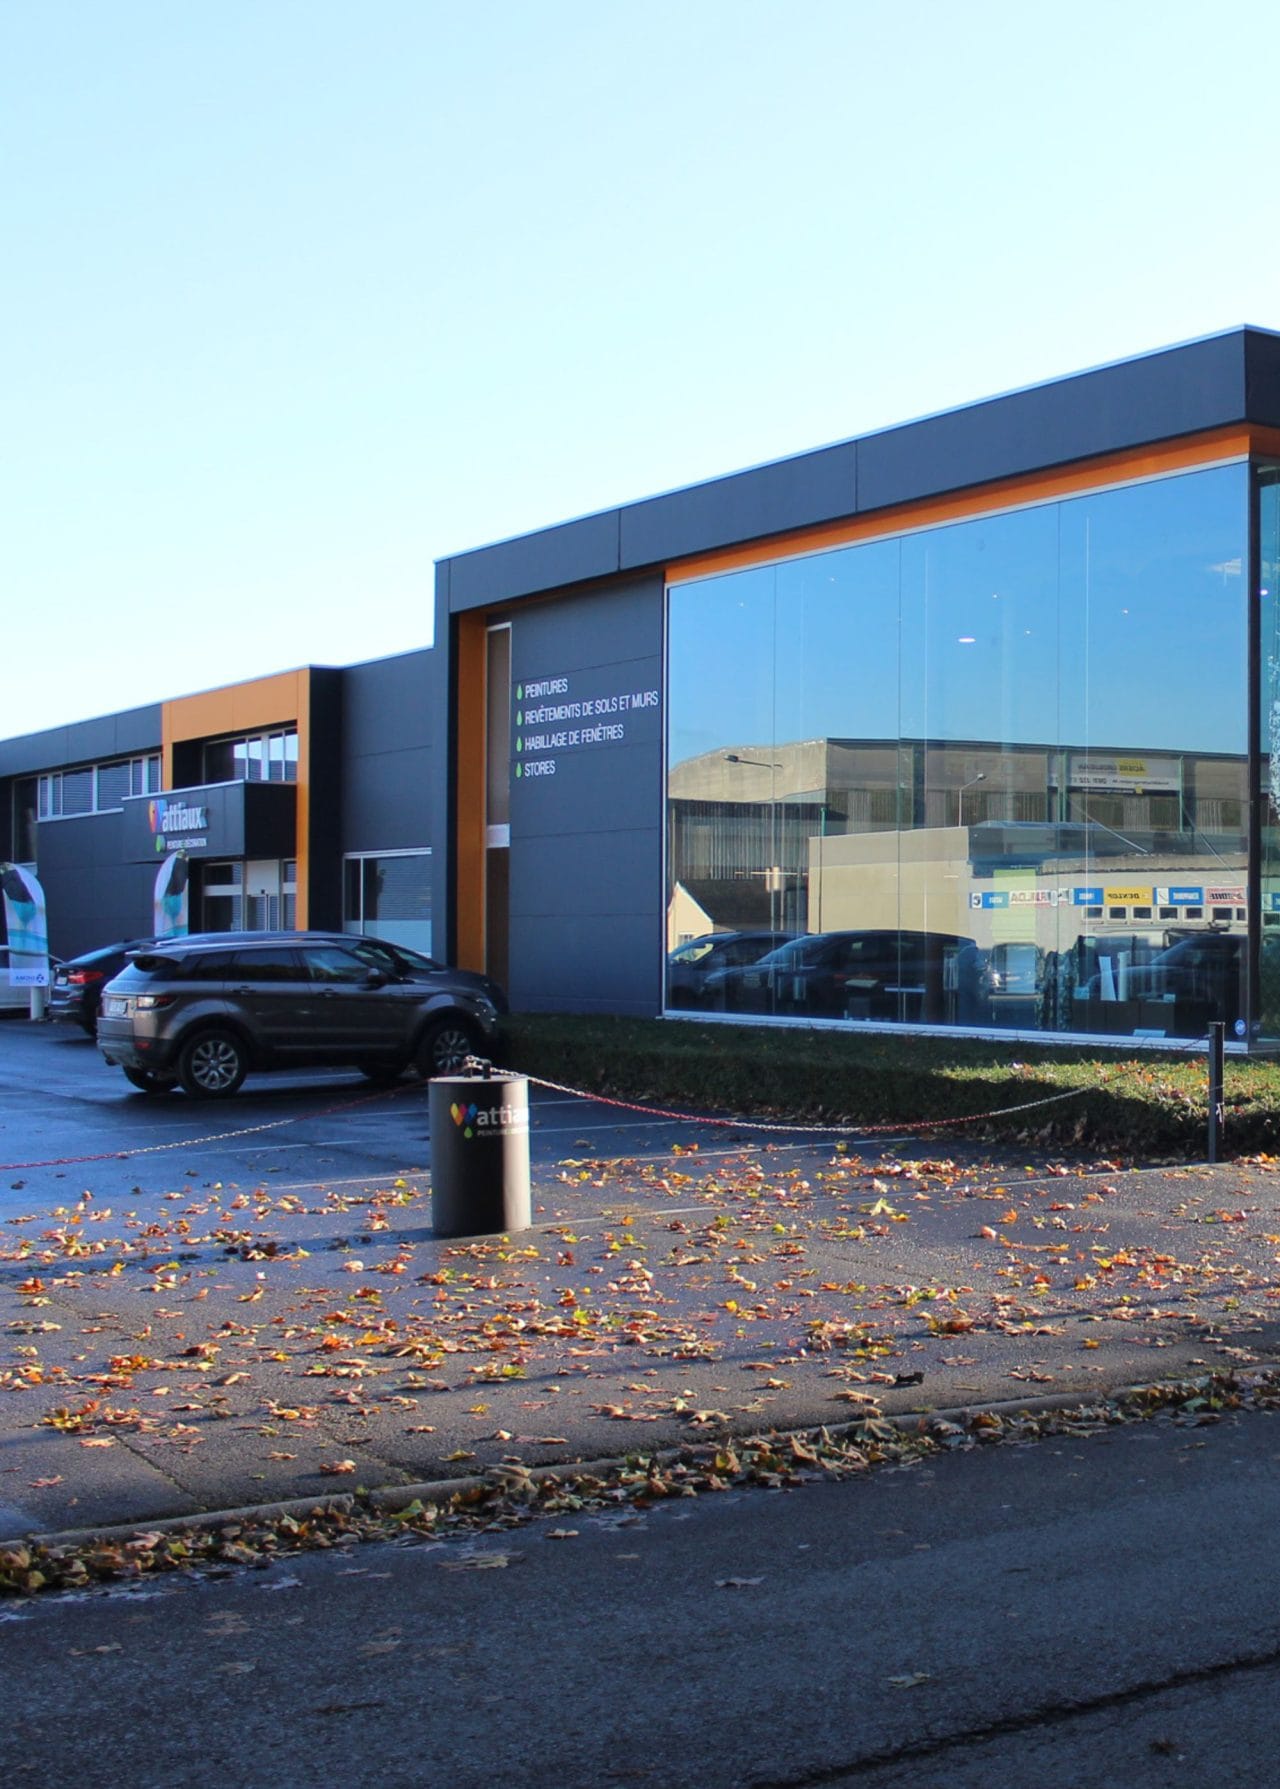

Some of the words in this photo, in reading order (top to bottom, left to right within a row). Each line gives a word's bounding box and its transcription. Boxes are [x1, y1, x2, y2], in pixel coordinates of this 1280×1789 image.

[524, 678, 568, 699] PEINTURES
[524, 704, 581, 725] REVÊTEMENTS
[582, 701, 594, 716] DE
[595, 697, 618, 714] SOLS
[619, 695, 630, 711] ET
[631, 690, 659, 709] MURS
[524, 731, 568, 751] HABILLAGE
[569, 729, 580, 744] DE
[581, 723, 624, 744] FENÊTRES
[524, 760, 556, 777] STORES
